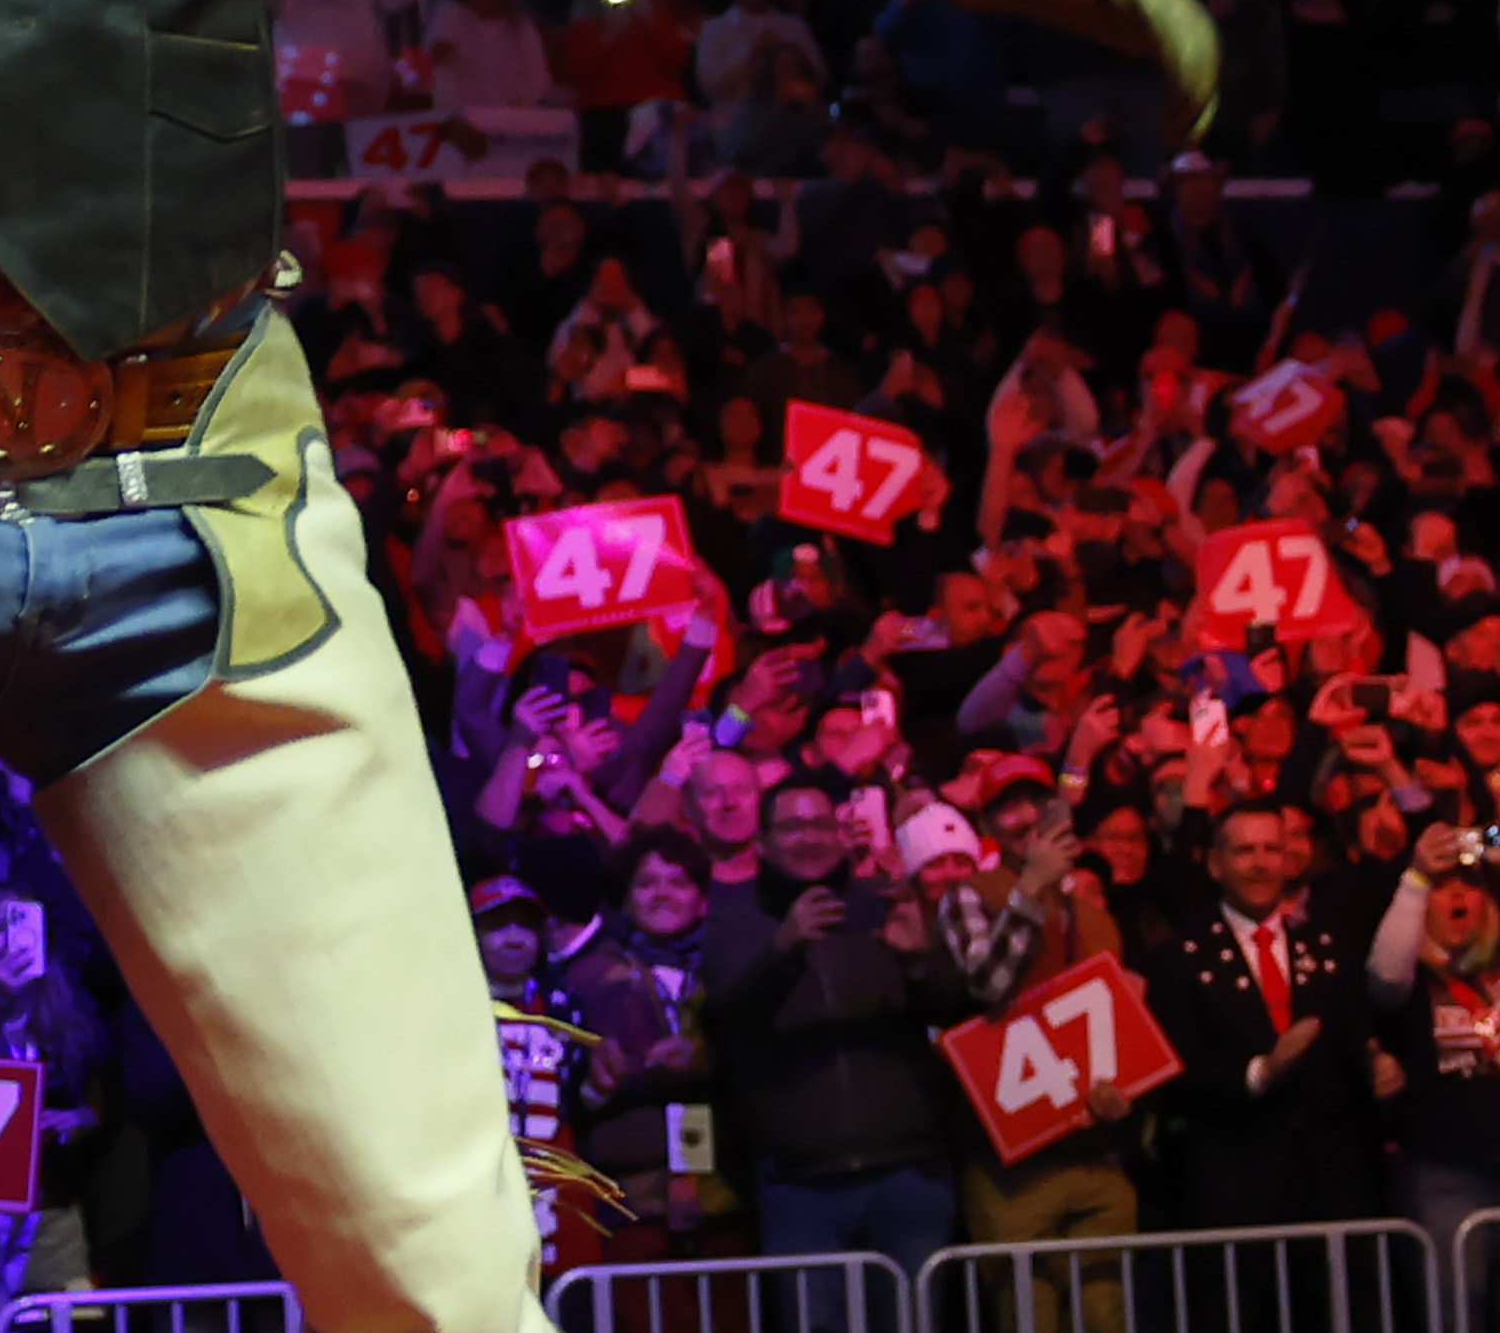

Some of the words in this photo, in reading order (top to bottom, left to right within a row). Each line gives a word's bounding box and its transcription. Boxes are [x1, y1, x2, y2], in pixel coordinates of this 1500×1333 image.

[363, 122, 443, 171] 47
[800, 427, 922, 521] 47
[534, 514, 666, 610] 47
[1210, 535, 1329, 625] 47
[993, 978, 1118, 1116] 47
